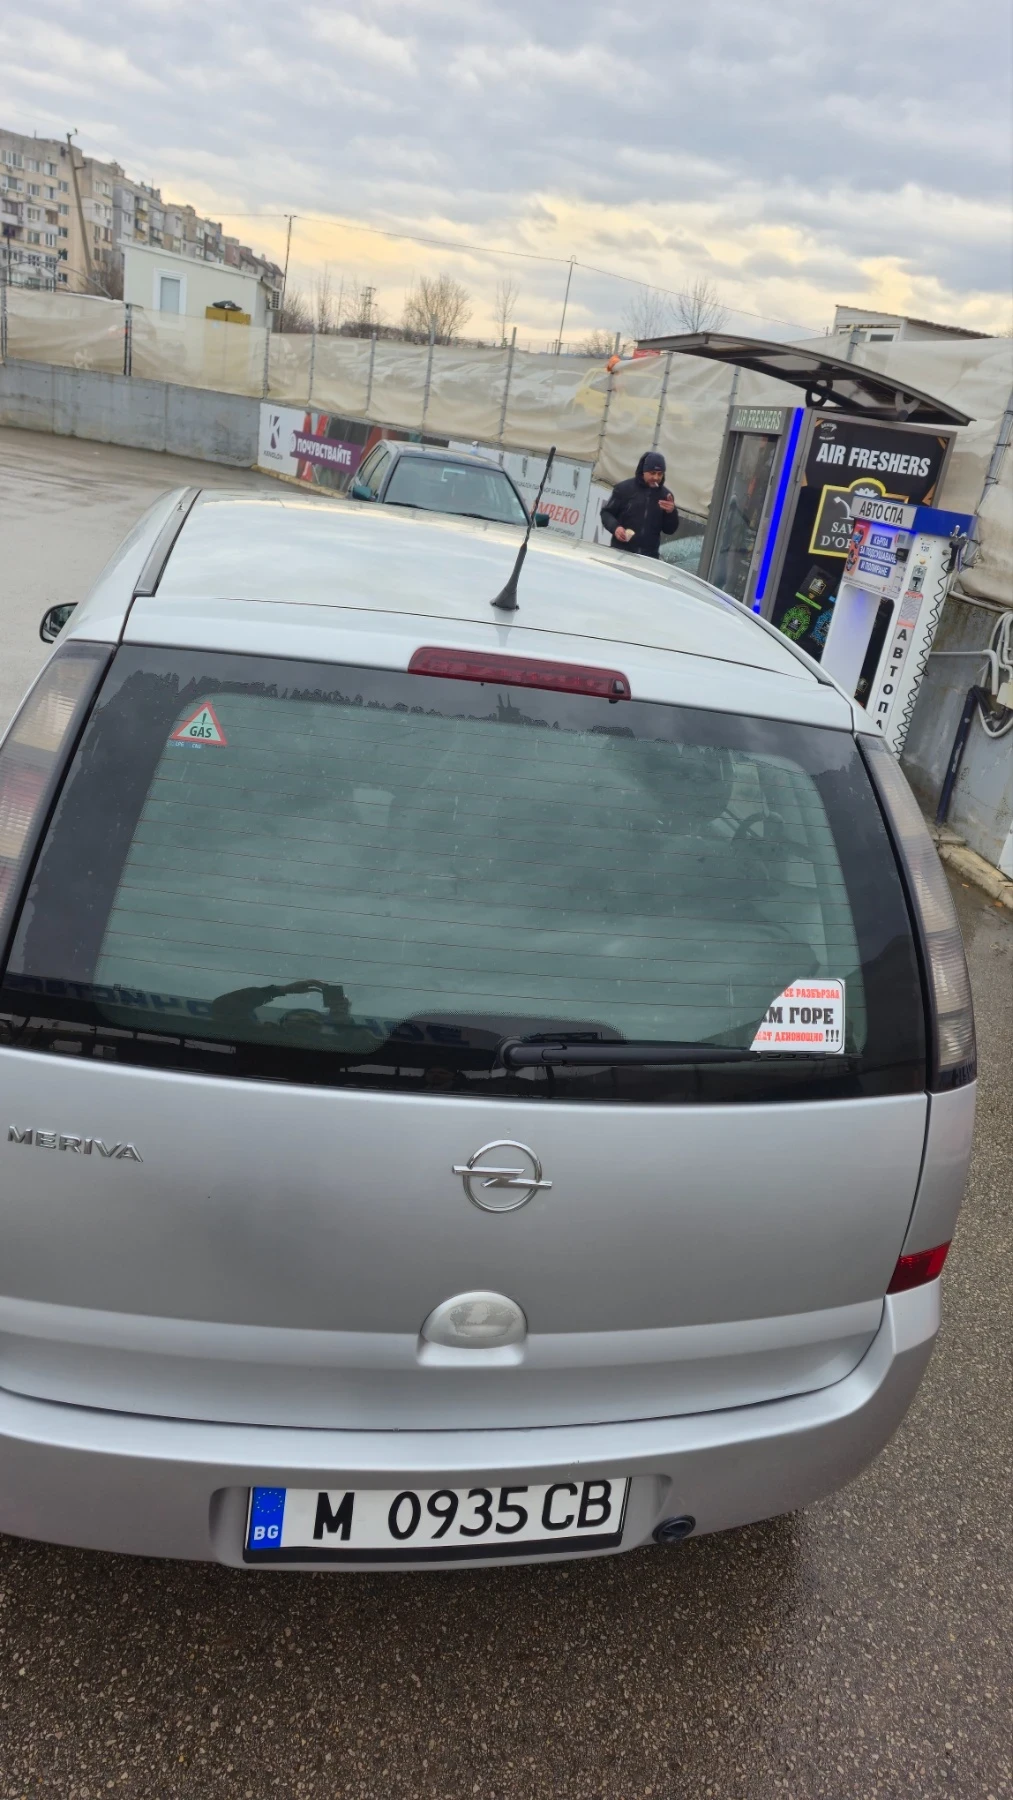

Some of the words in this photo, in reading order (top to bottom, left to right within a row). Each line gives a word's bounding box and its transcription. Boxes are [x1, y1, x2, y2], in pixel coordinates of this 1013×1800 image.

[735, 409, 748, 427] AIR
[746, 409, 782, 430] FRESHERS
[297, 439, 352, 465] ПОЧУВСТВАЙТЕ
[816, 442, 847, 465] AIR
[848, 446, 931, 478] FRESHERS
[859, 500, 883, 520] АВТО
[883, 505, 904, 525] СПА
[189, 725, 212, 738] GAS
[789, 1007, 834, 1025] ГОРЕ
[7, 1125, 144, 1163] MERIVA
[312, 1492, 355, 1541] M
[387, 1486, 530, 1541] 0935
[540, 1479, 613, 1532] CB
[253, 1524, 279, 1541] BG
